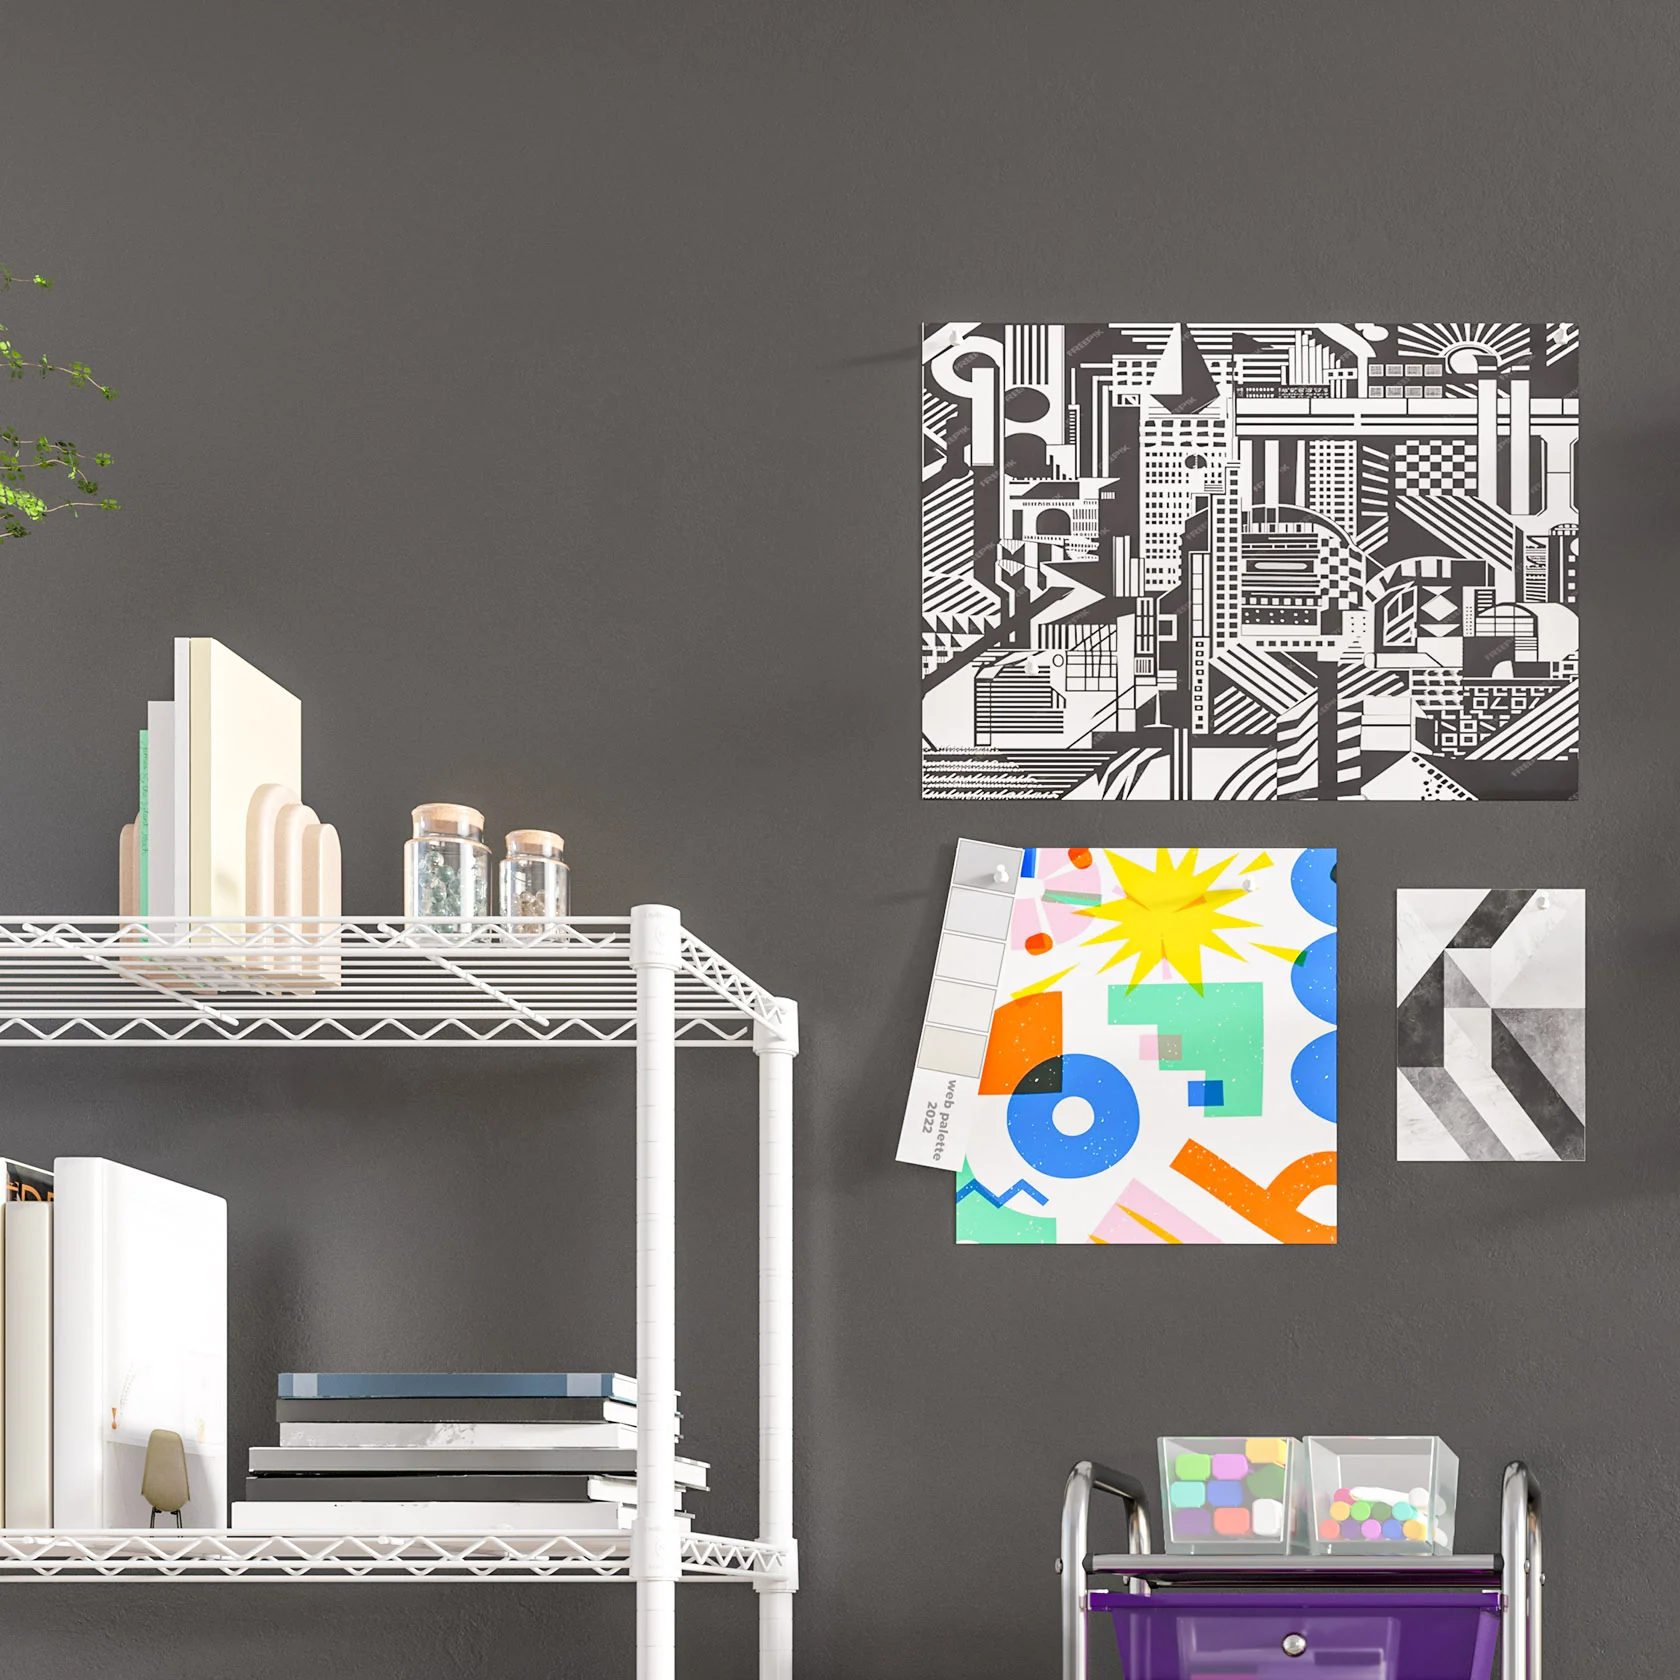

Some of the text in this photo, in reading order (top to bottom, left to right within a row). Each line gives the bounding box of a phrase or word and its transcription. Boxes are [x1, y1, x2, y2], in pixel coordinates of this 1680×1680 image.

[921, 1101, 938, 1134] 2022
[932, 1079, 957, 1161] web palette
